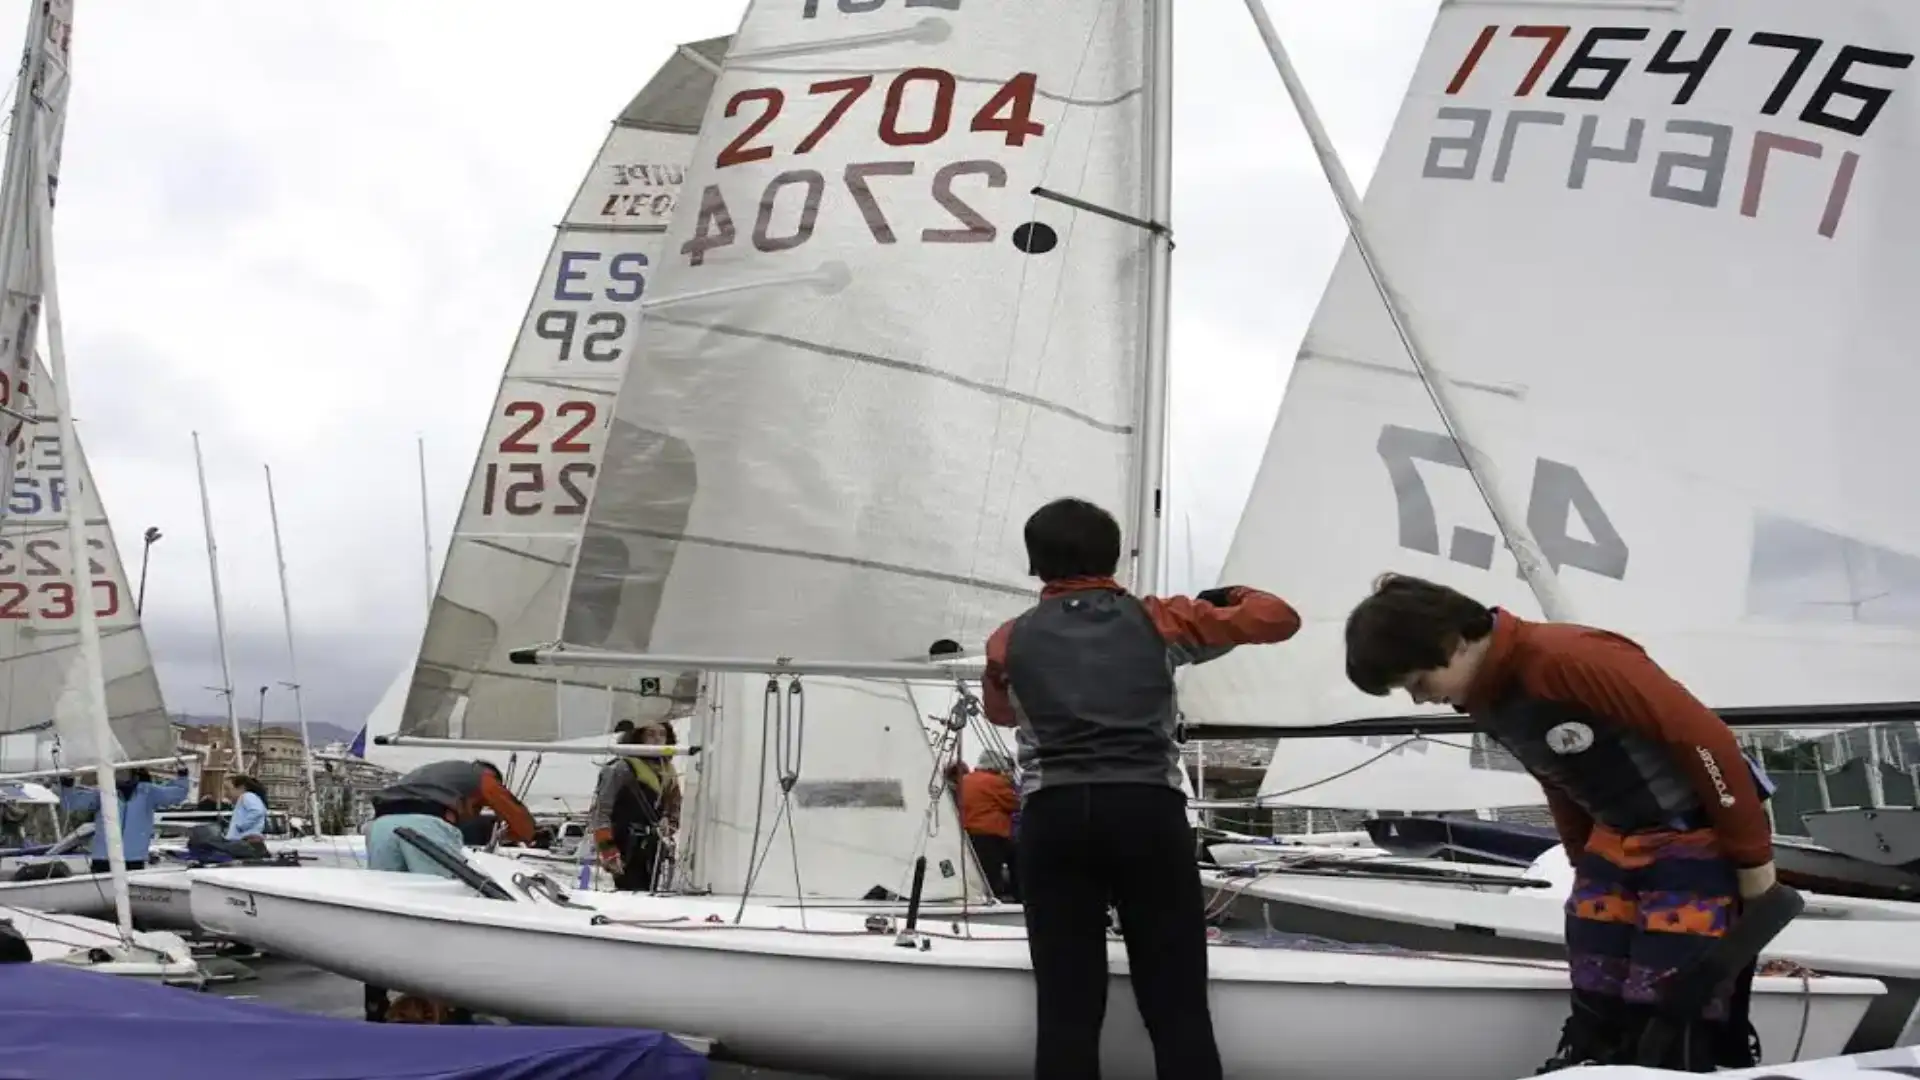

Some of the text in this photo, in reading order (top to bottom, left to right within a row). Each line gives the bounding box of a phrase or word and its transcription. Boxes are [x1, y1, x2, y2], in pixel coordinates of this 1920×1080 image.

[716, 67, 1045, 168] 2704
[1445, 25, 1915, 136] 176476
[554, 251, 648, 302] ES
[499, 401, 596, 453] 22
